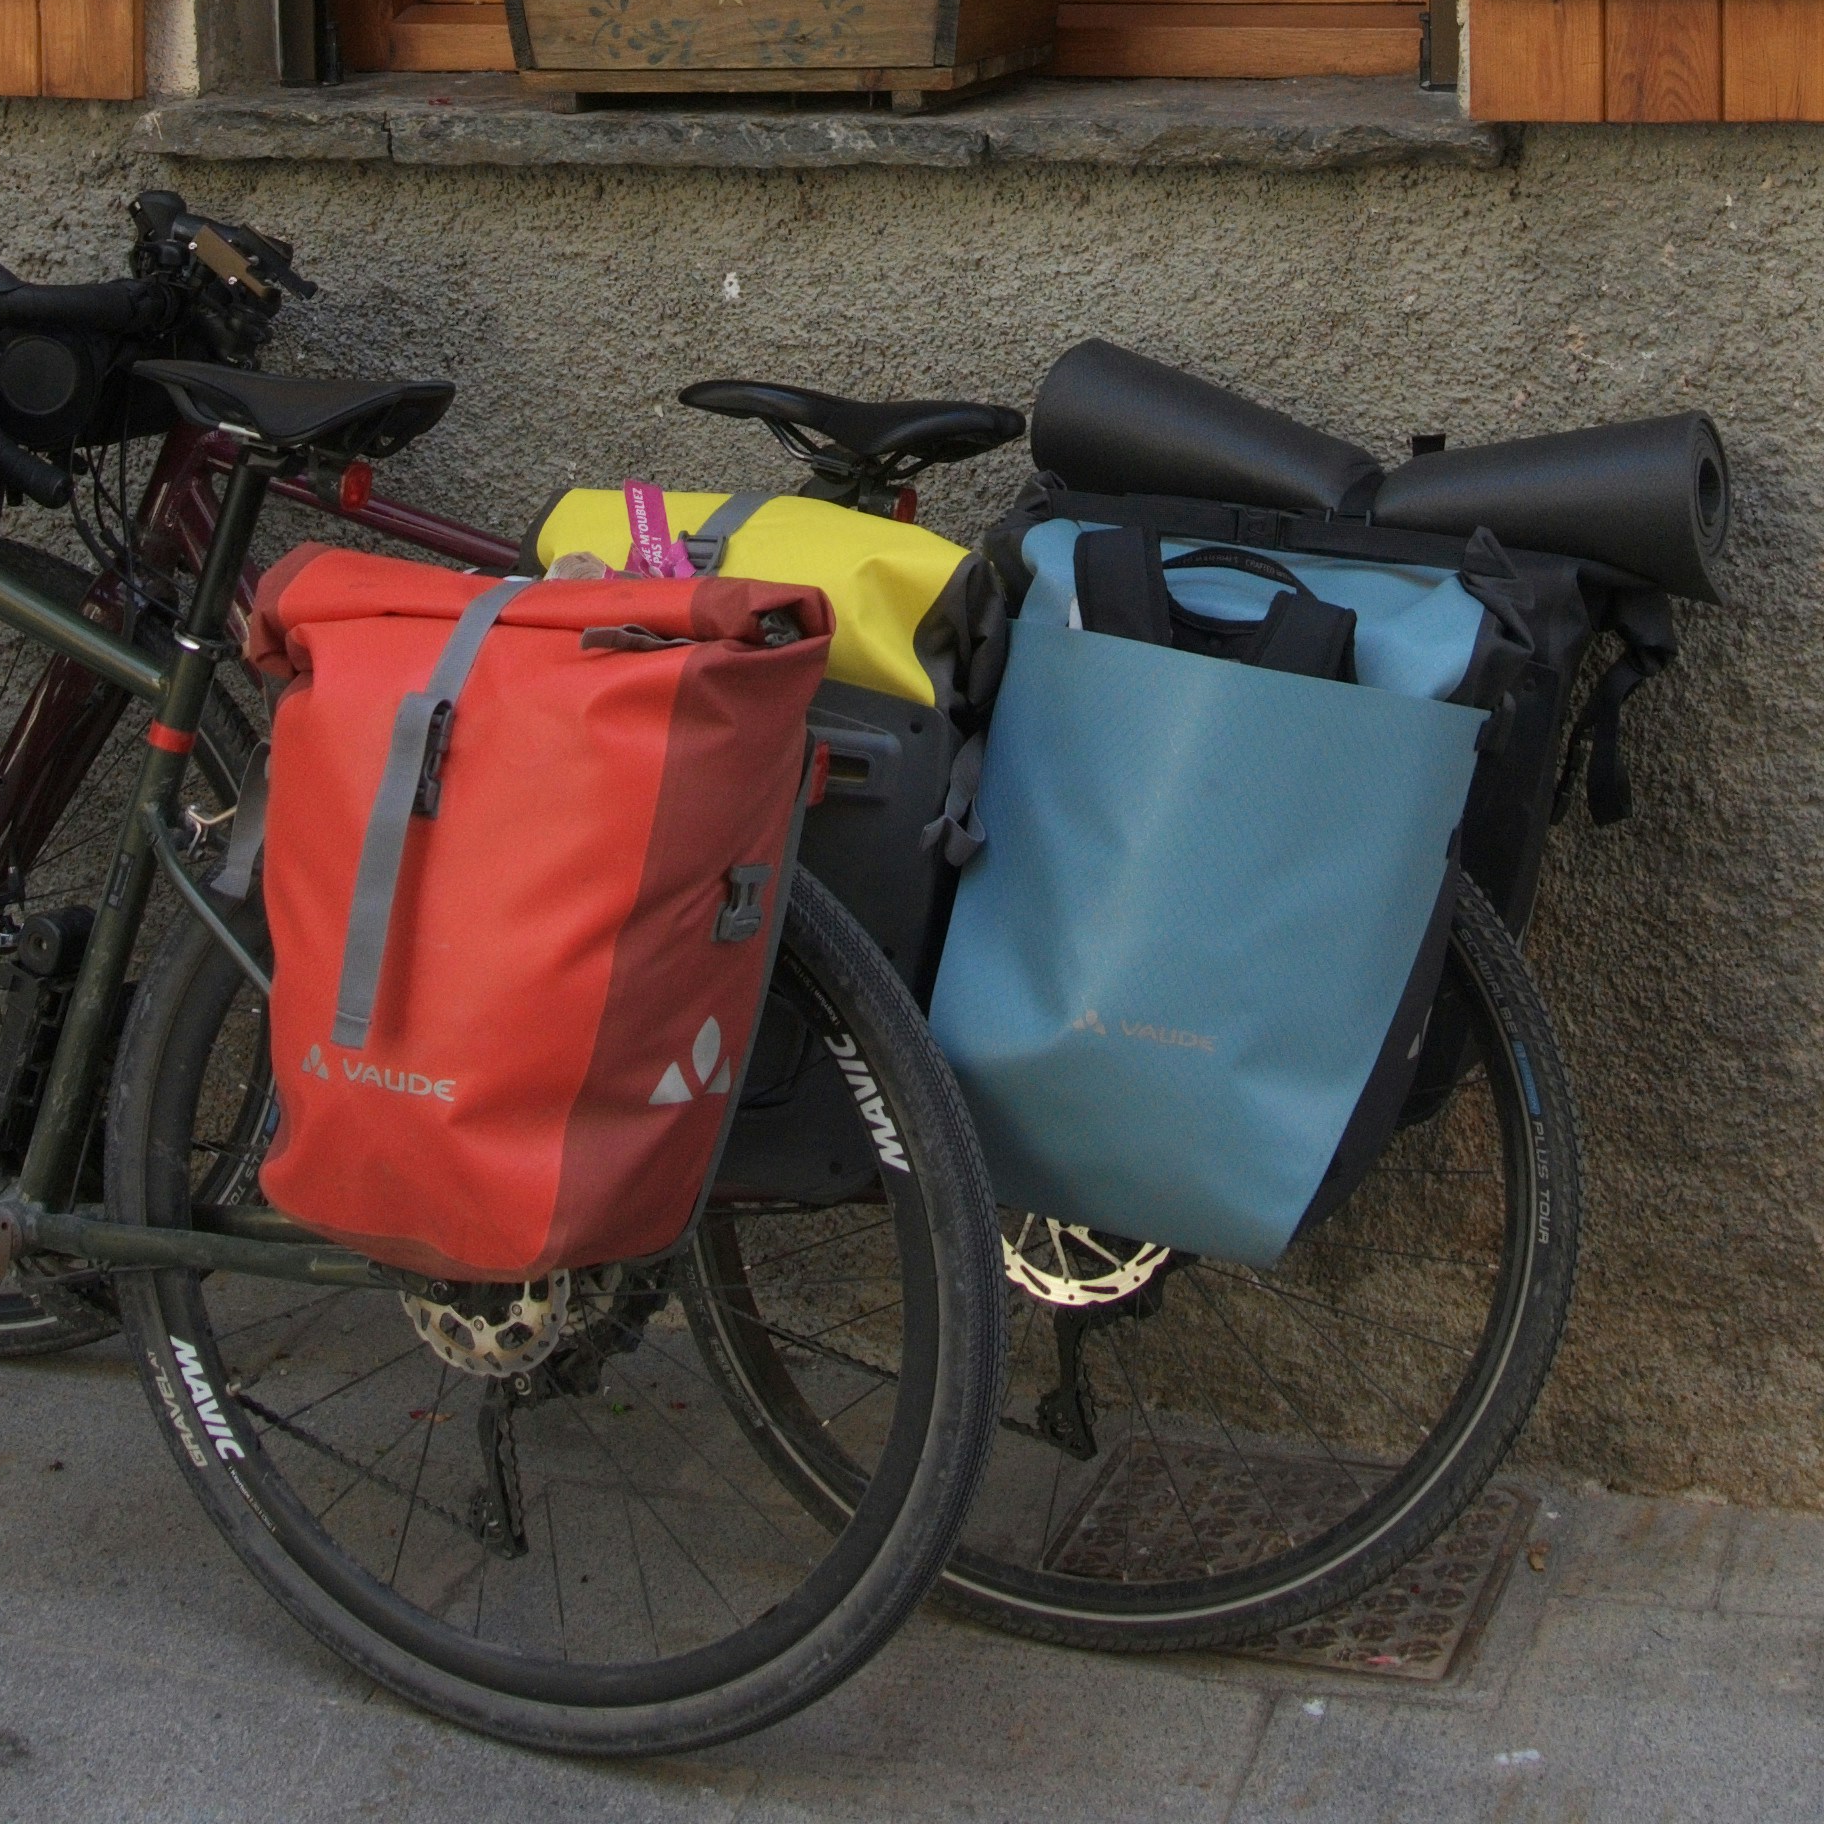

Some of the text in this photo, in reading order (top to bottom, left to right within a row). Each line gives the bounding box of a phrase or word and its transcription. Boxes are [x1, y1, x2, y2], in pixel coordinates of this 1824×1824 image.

[632, 487, 650, 544] M'OUBLIEZ
[652, 545, 663, 566] PAS
[1458, 929, 1518, 1033] SCHWALBE
[342, 1058, 456, 1102] VAUDE
[1119, 1019, 1219, 1054] VAUDE
[824, 1033, 910, 1172] MAVIC
[1533, 1121, 1550, 1244] PLUS TOUR
[156, 1367, 208, 1467] GRAVEL
[171, 1335, 245, 1460] MAVIC
